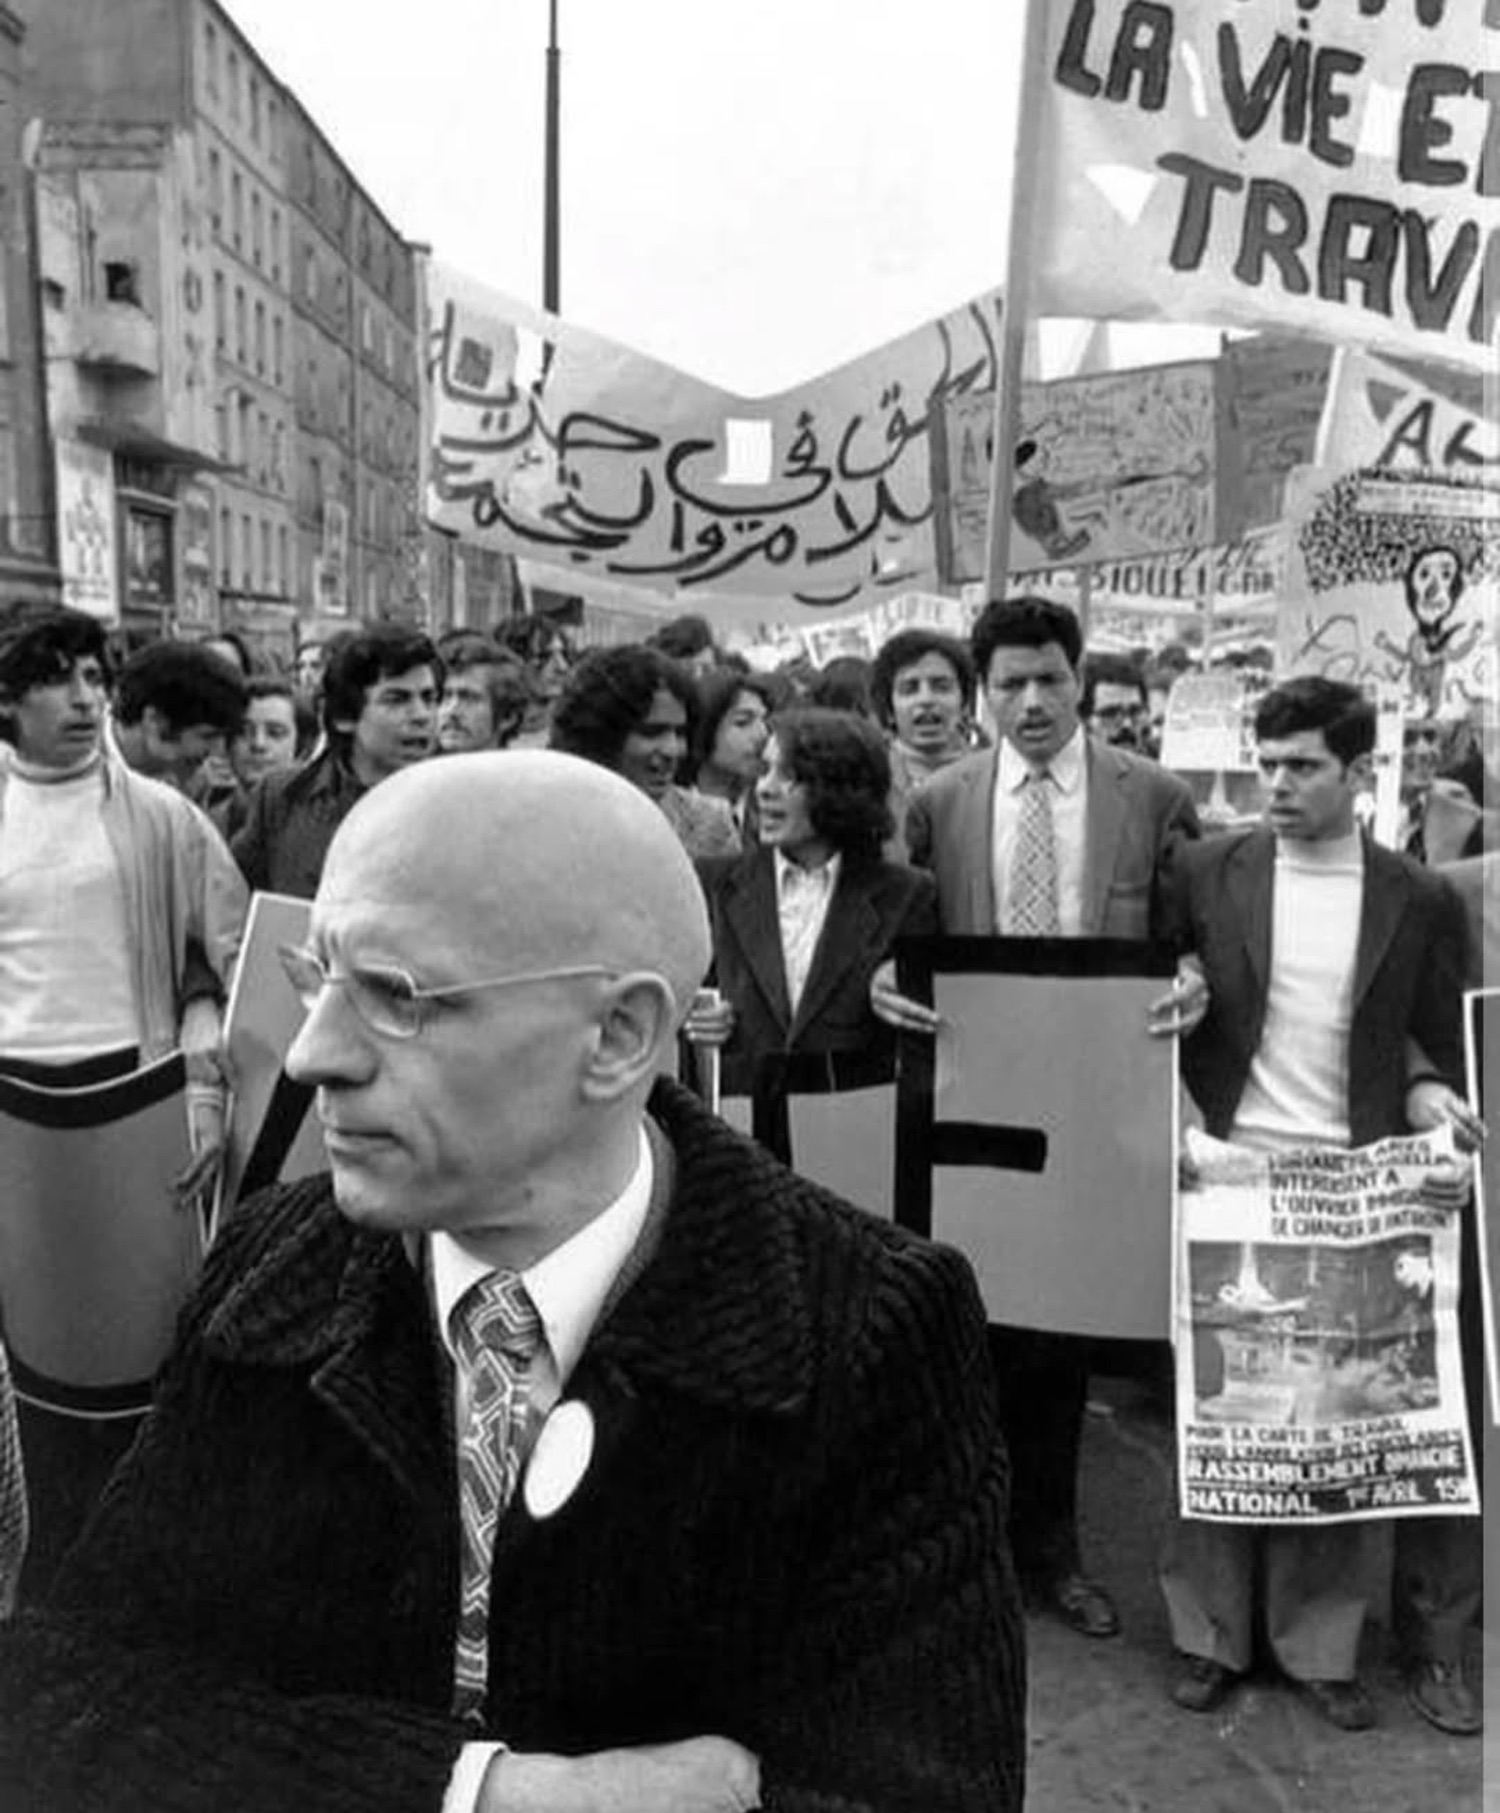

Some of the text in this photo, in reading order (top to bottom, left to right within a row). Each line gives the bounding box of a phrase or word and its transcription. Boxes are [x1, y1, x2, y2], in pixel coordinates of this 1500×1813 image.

[1054, 0, 1174, 112] LA
[1216, 16, 1365, 168] VIE
[1231, 1426, 1254, 1442] LA
[1258, 1426, 1307, 1444] CARTE
[1187, 1453, 1380, 1483] RASSEMBLEMENT
[1187, 1489, 1319, 1514] NATIONAL
